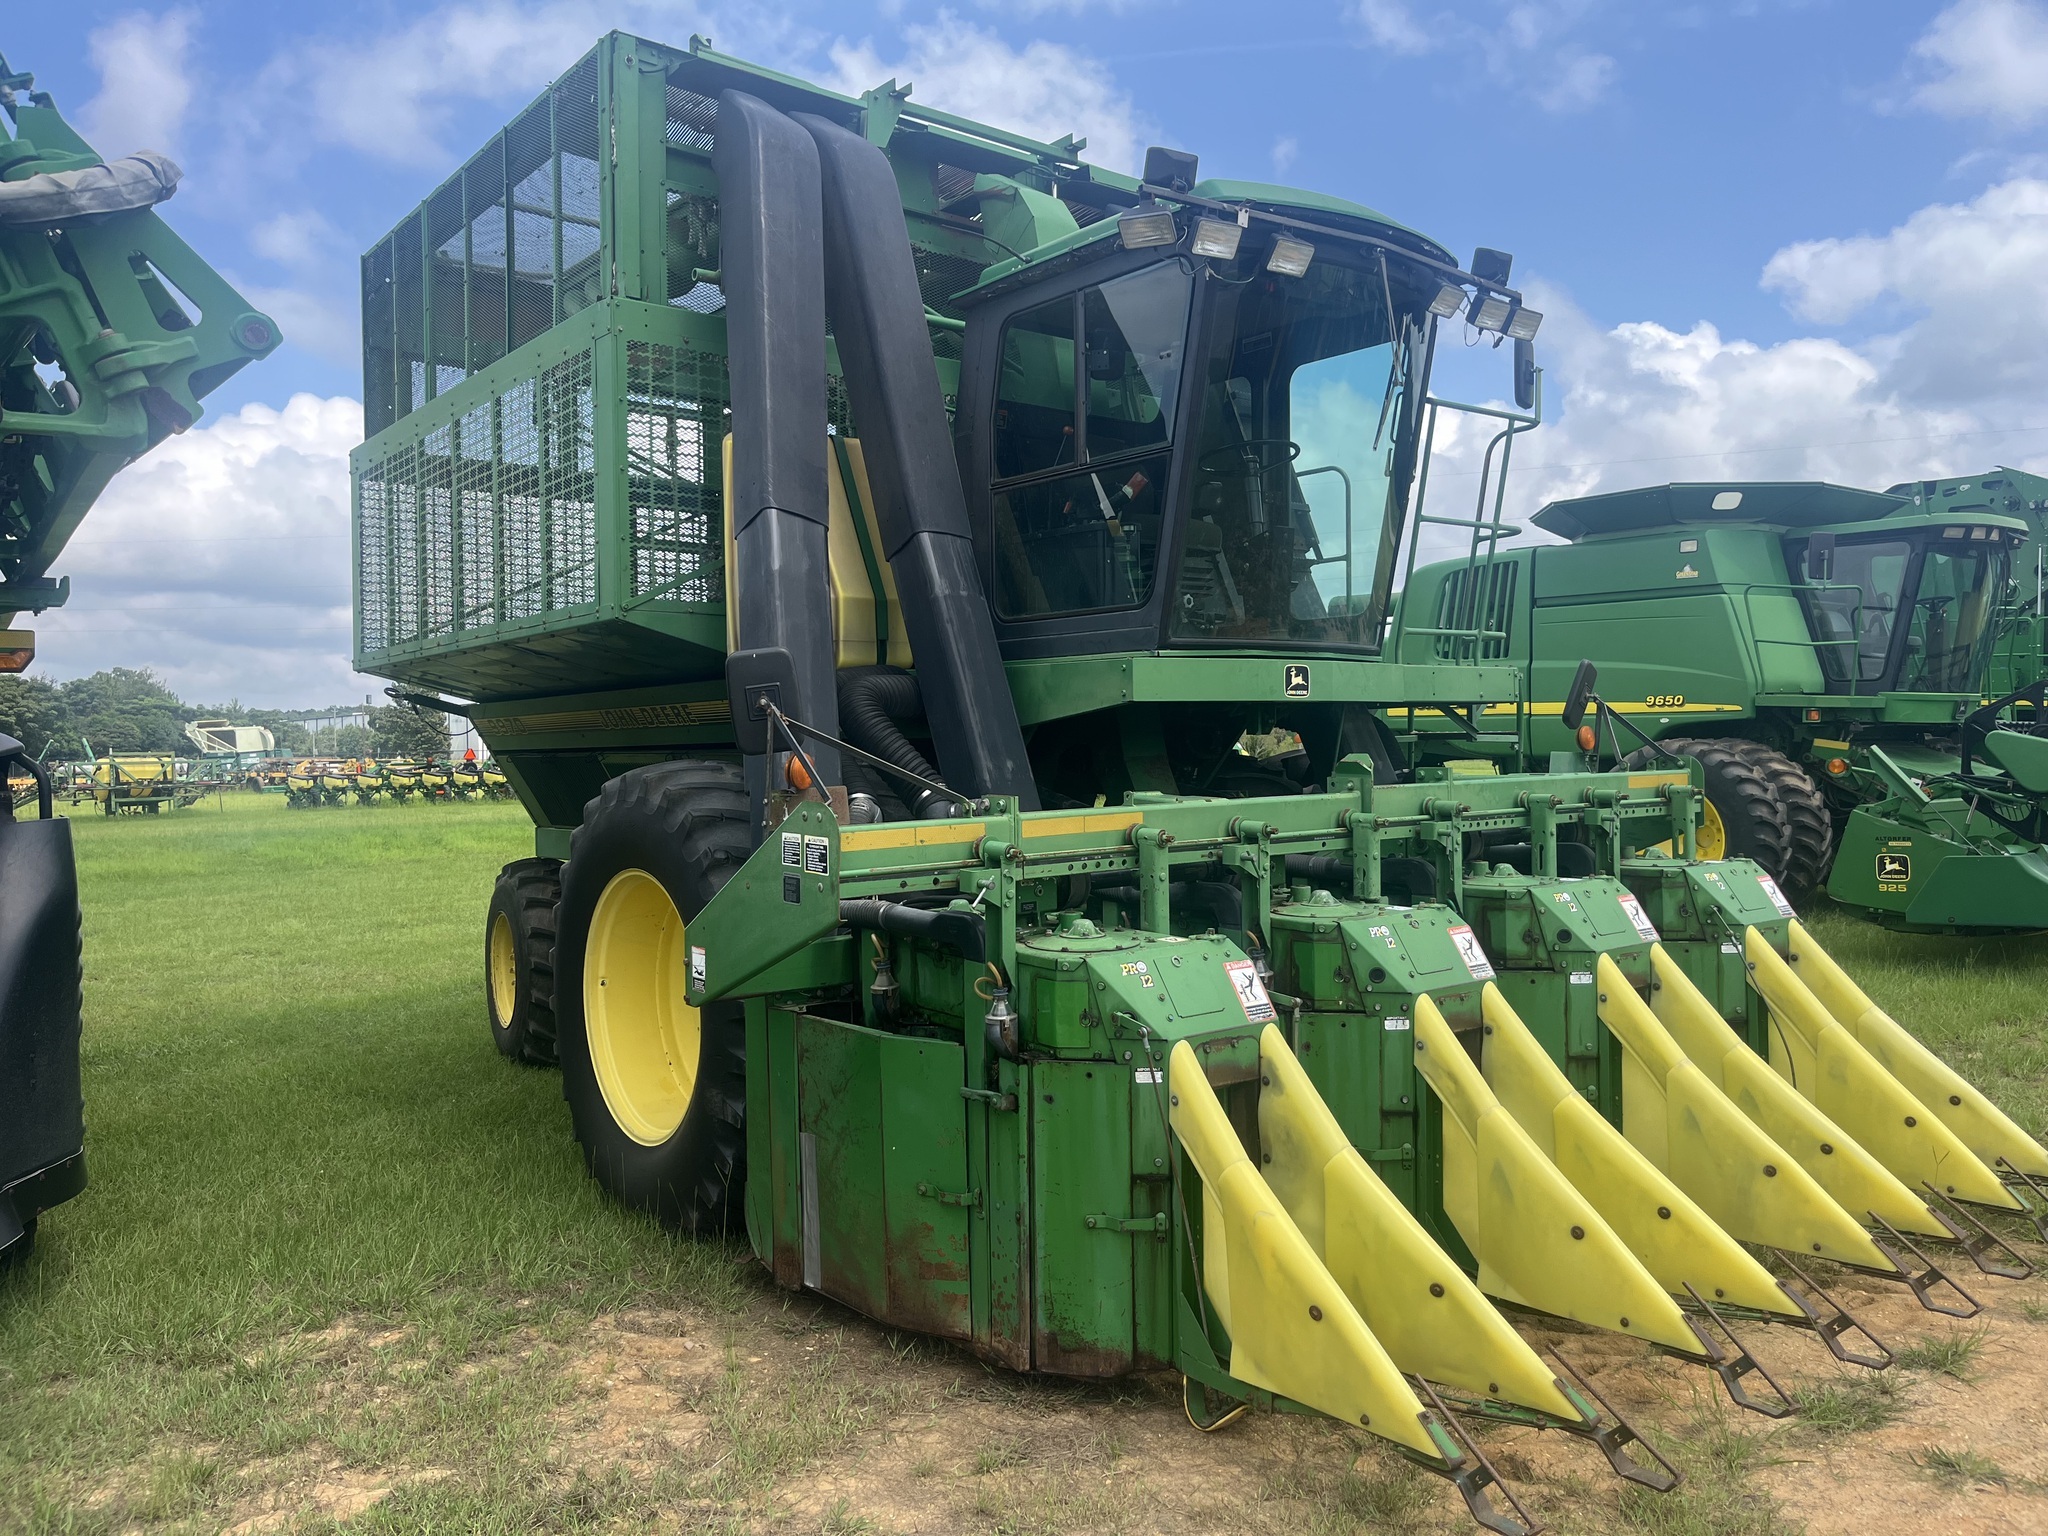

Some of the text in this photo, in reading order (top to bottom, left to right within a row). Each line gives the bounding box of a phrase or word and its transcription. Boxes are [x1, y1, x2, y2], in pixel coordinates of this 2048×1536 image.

[1645, 695, 1684, 707] 9650
[600, 704, 700, 730] JOHN DEERE
[487, 717, 528, 736] 9970
[1878, 884, 1907, 892] 925
[1553, 892, 1571, 903] PRO
[1568, 902, 1578, 913] 12
[1368, 925, 1390, 938] PRO
[1385, 937, 1397, 949] 12
[1120, 961, 1148, 976] PRO
[1140, 974, 1155, 988] 12
